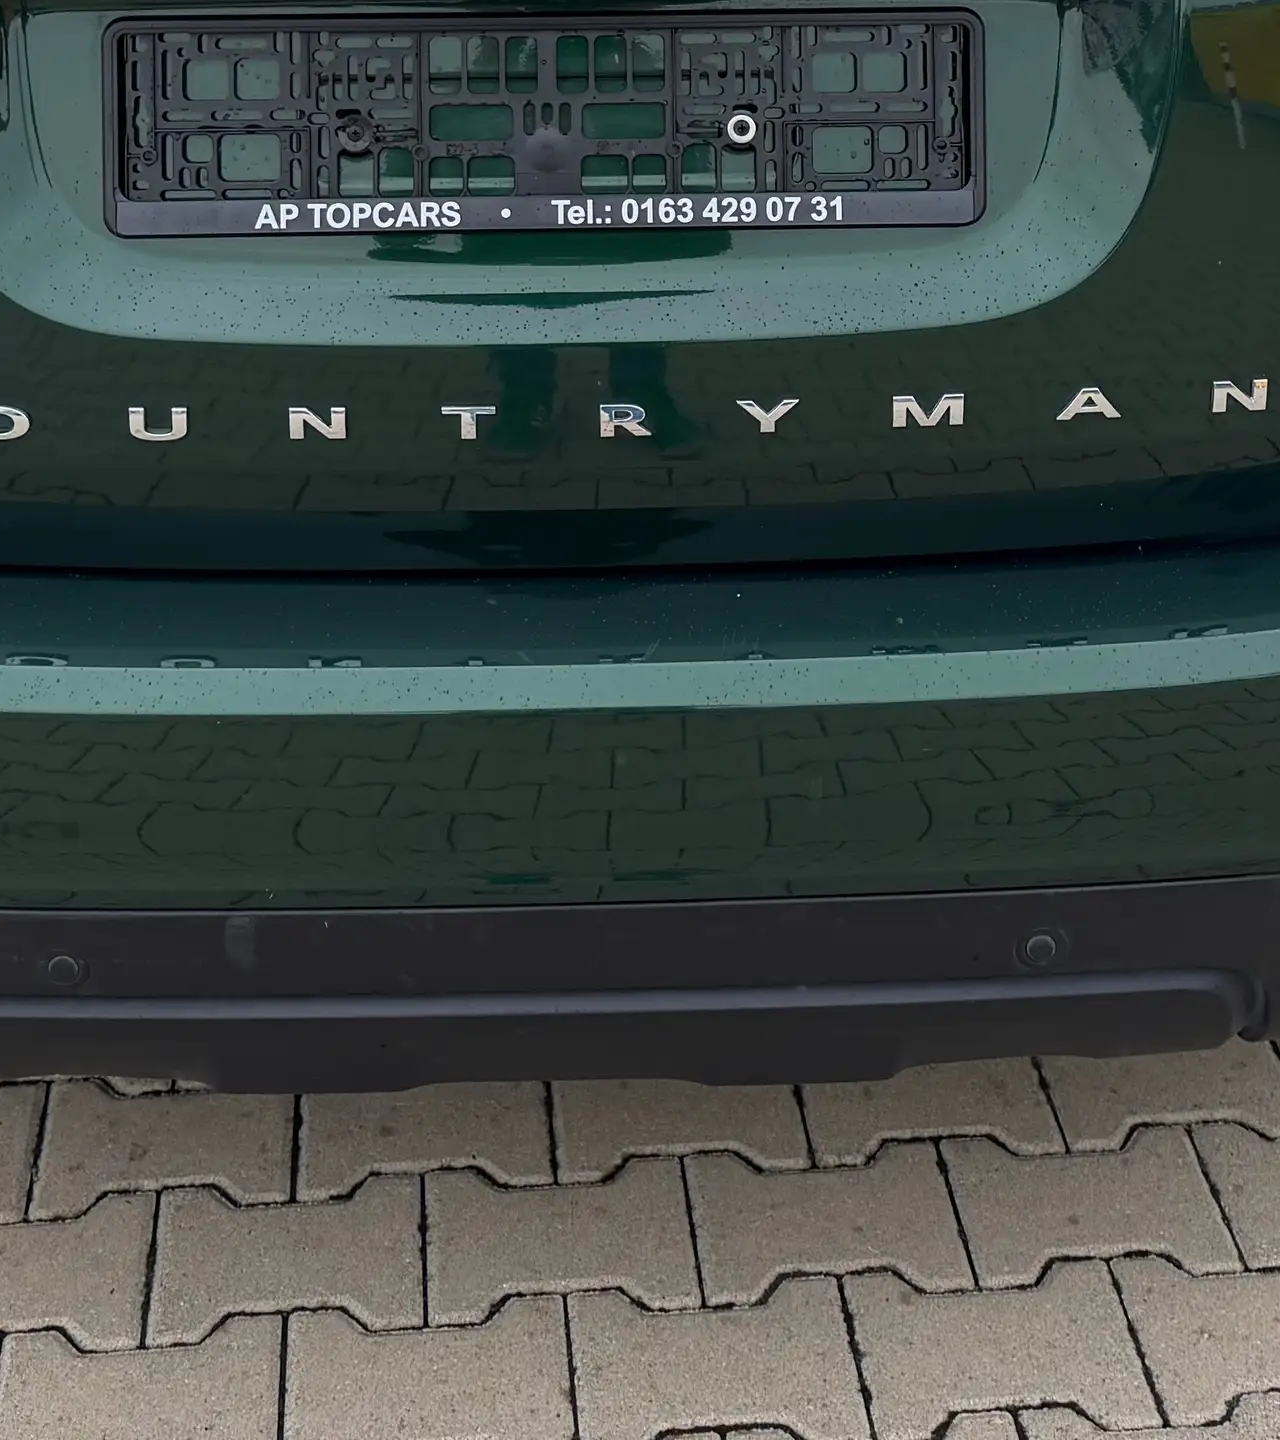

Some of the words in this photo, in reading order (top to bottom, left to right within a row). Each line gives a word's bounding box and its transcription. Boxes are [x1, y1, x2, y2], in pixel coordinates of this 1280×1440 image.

[255, 203, 299, 229] AP
[307, 201, 461, 229] TOPCARS
[551, 199, 612, 225] Tel.:
[621, 198, 694, 224] 0163
[702, 197, 757, 223] 429
[765, 196, 802, 222] 07
[809, 196, 844, 221] 31
